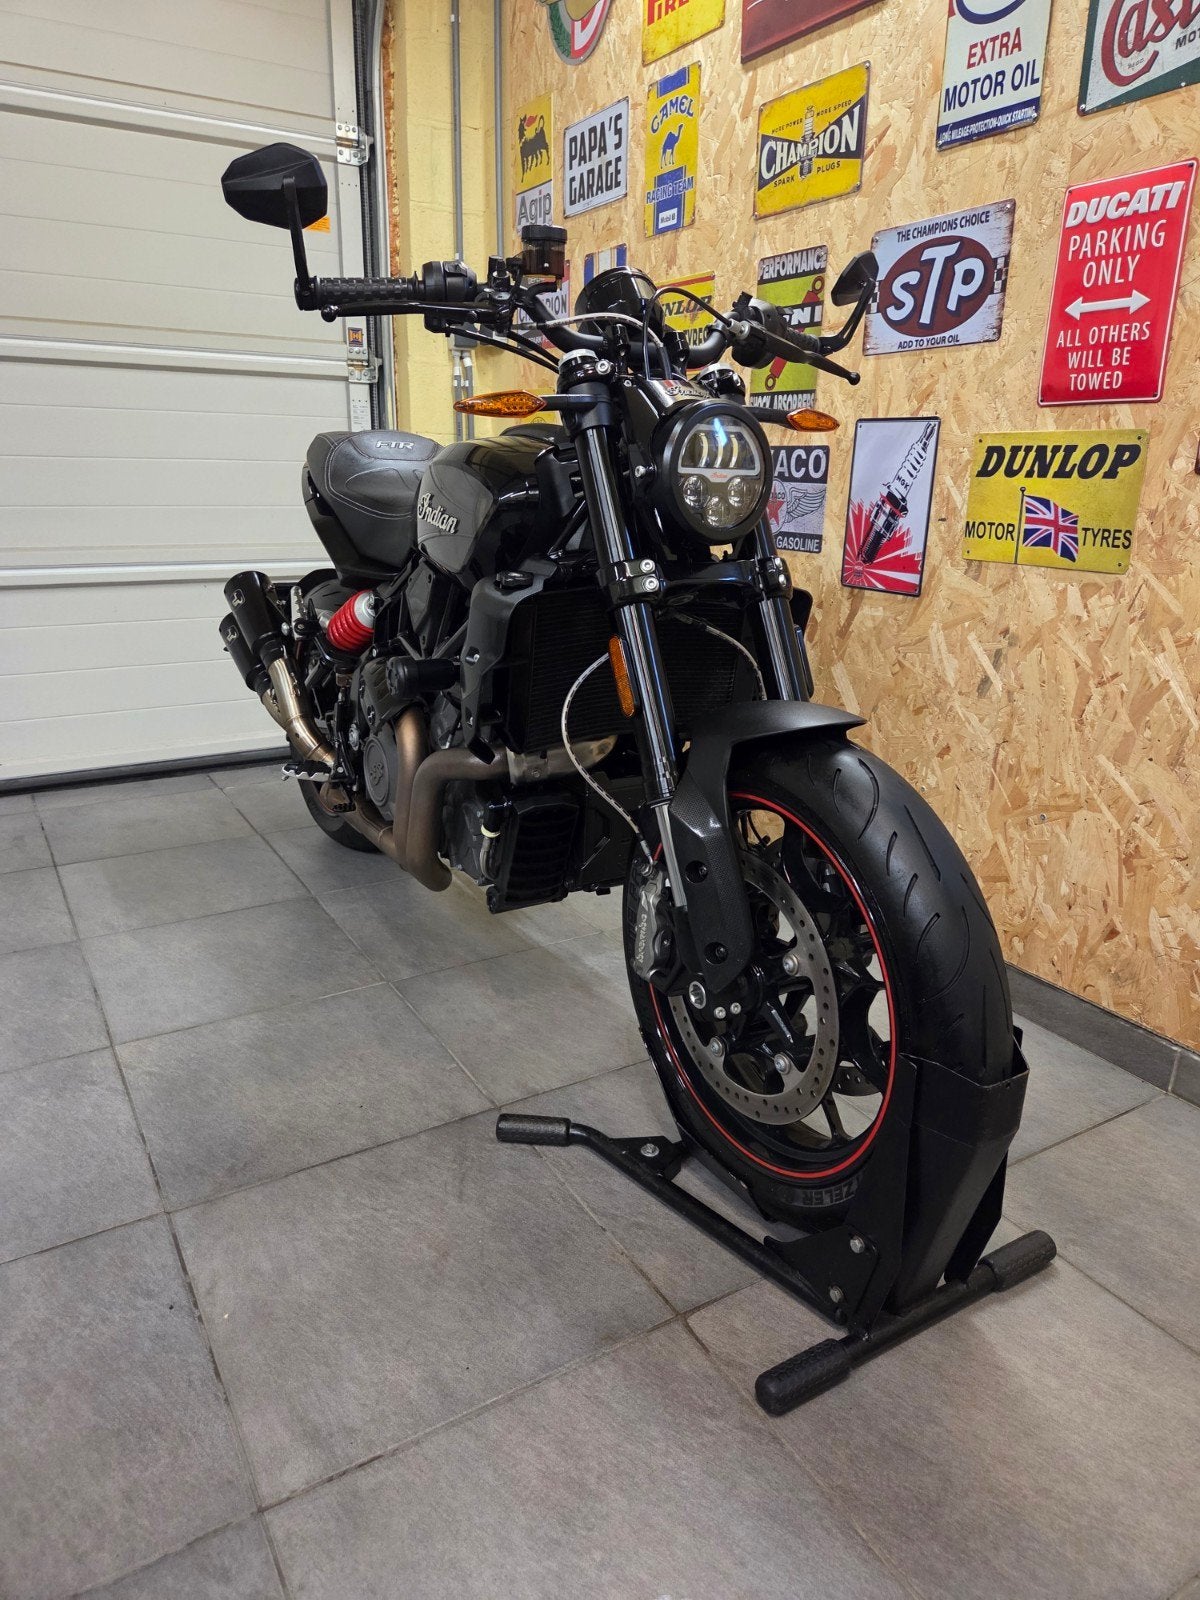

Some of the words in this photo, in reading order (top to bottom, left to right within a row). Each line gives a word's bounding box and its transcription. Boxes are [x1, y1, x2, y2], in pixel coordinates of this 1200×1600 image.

[967, 27, 1022, 69] EXTRA
[943, 70, 1006, 112] MOTOR
[1011, 59, 1040, 91] OIL
[651, 94, 694, 134] CAMEL
[772, 125, 784, 134] MORE
[785, 118, 803, 129] POWER
[816, 107, 831, 117] MORE
[833, 100, 852, 111] SPEED
[569, 113, 622, 170] PAPA'S
[760, 105, 861, 180] CHAMPION
[569, 156, 621, 206] GARAGE
[646, 183, 672, 204] RACING
[673, 176, 694, 195] TEAM
[774, 175, 795, 188] SPARK
[816, 161, 841, 174] PLUGS
[517, 189, 551, 225] Agip
[1065, 181, 1186, 228] DUCATI
[897, 231, 912, 242] THE
[912, 218, 958, 239] CHAMPIONS
[960, 210, 990, 228] CHOICE
[1068, 219, 1167, 261] PARKING
[758, 247, 827, 281] PERFORMANCE
[1083, 254, 1140, 288] ONLY
[886, 242, 985, 324] STP
[898, 340, 914, 350] ADD
[914, 339, 924, 348] TO
[925, 336, 947, 346] YOUR
[947, 334, 959, 343] OIL
[1056, 330, 1081, 348] ALL
[1088, 321, 1151, 345] OTHERS
[1068, 349, 1104, 369] WILL
[1111, 347, 1131, 366] BE
[1069, 371, 1123, 391] TOWED
[375, 440, 415, 450] FTR
[975, 444, 1142, 479] DUNLOP
[771, 449, 826, 479] ACO
[896, 476, 910, 491] NGK
[417, 492, 459, 534] Indian
[776, 536, 820, 552] GASOLINE
[965, 520, 1015, 541] MOTOR
[1082, 527, 1132, 550] TYRES
